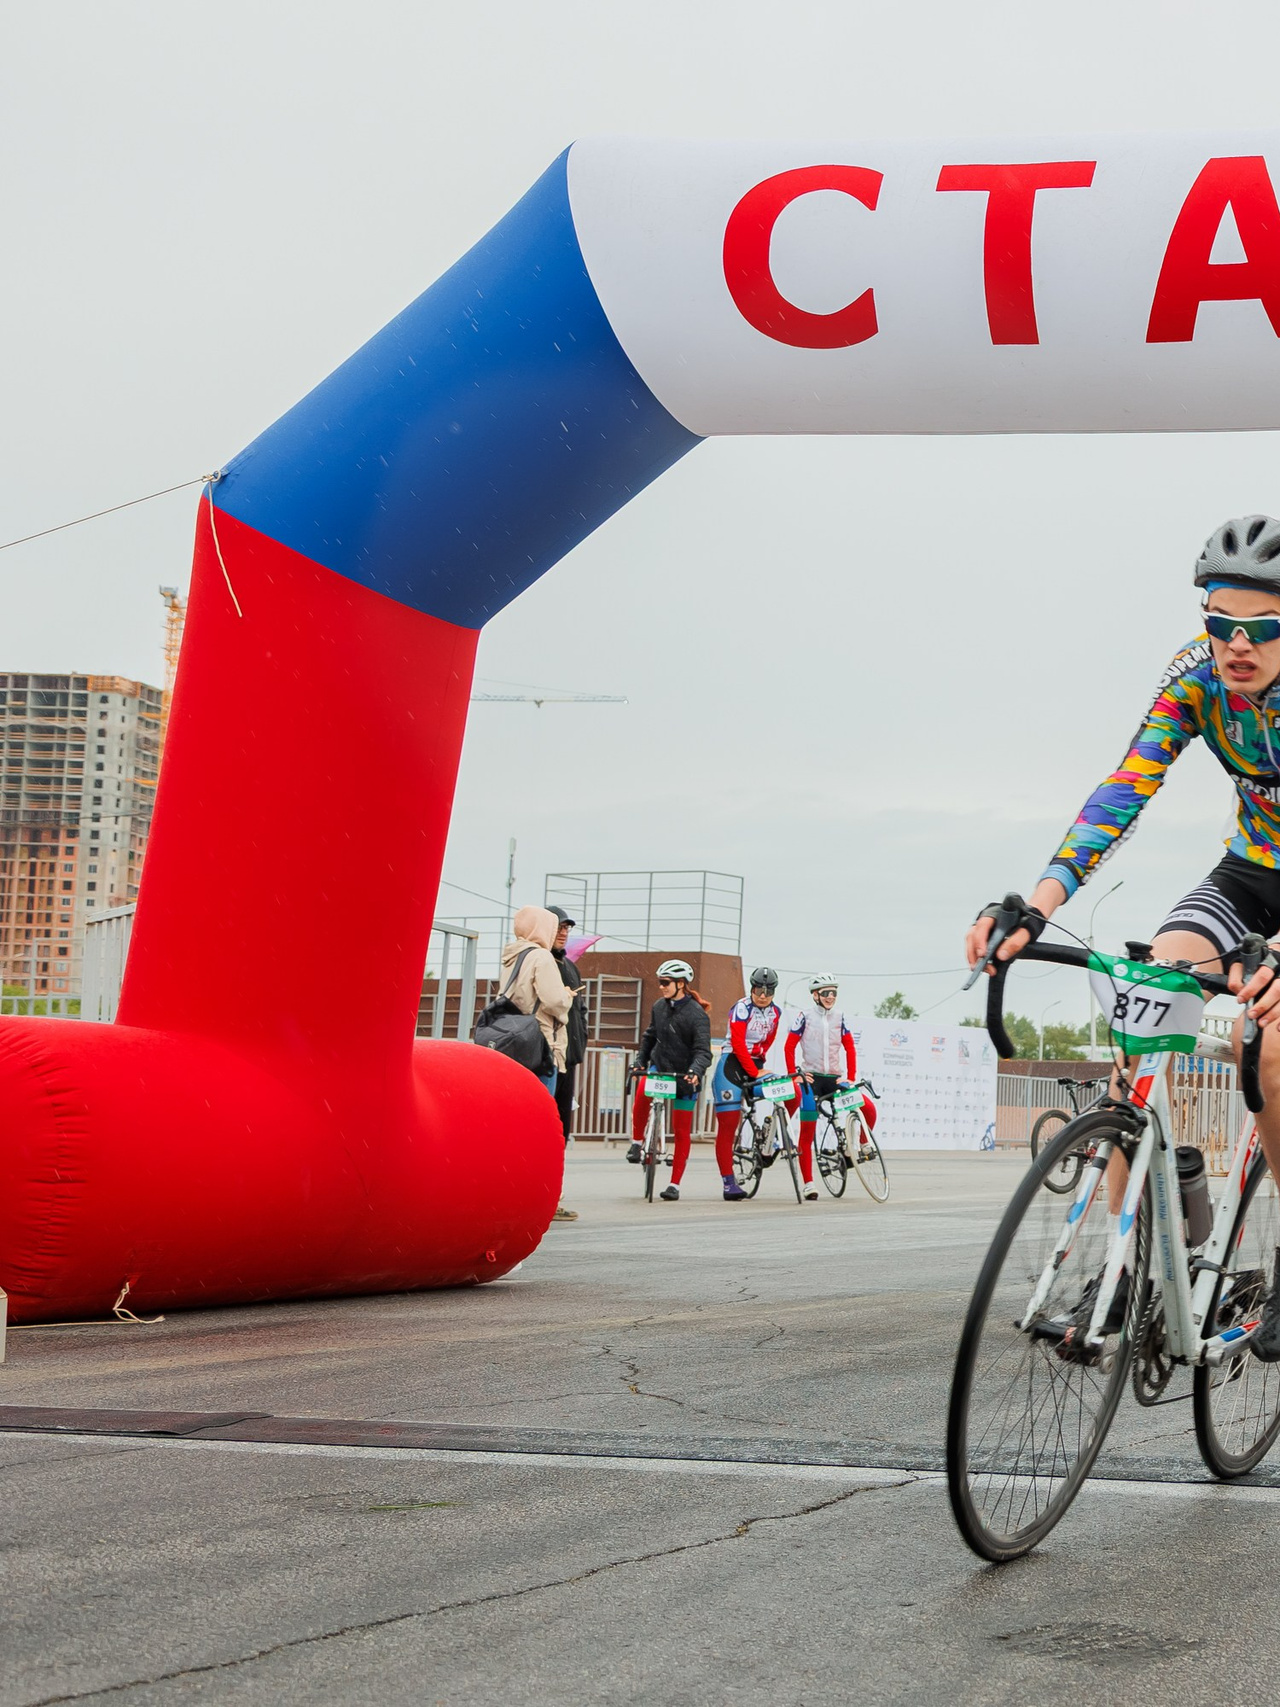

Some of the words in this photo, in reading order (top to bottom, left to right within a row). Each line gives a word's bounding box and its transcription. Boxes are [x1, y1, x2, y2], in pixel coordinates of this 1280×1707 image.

[1113, 992, 1172, 1028] 877
[654, 1082, 669, 1091] 859
[771, 1086, 786, 1095] 895
[841, 1095, 854, 1105] 897
